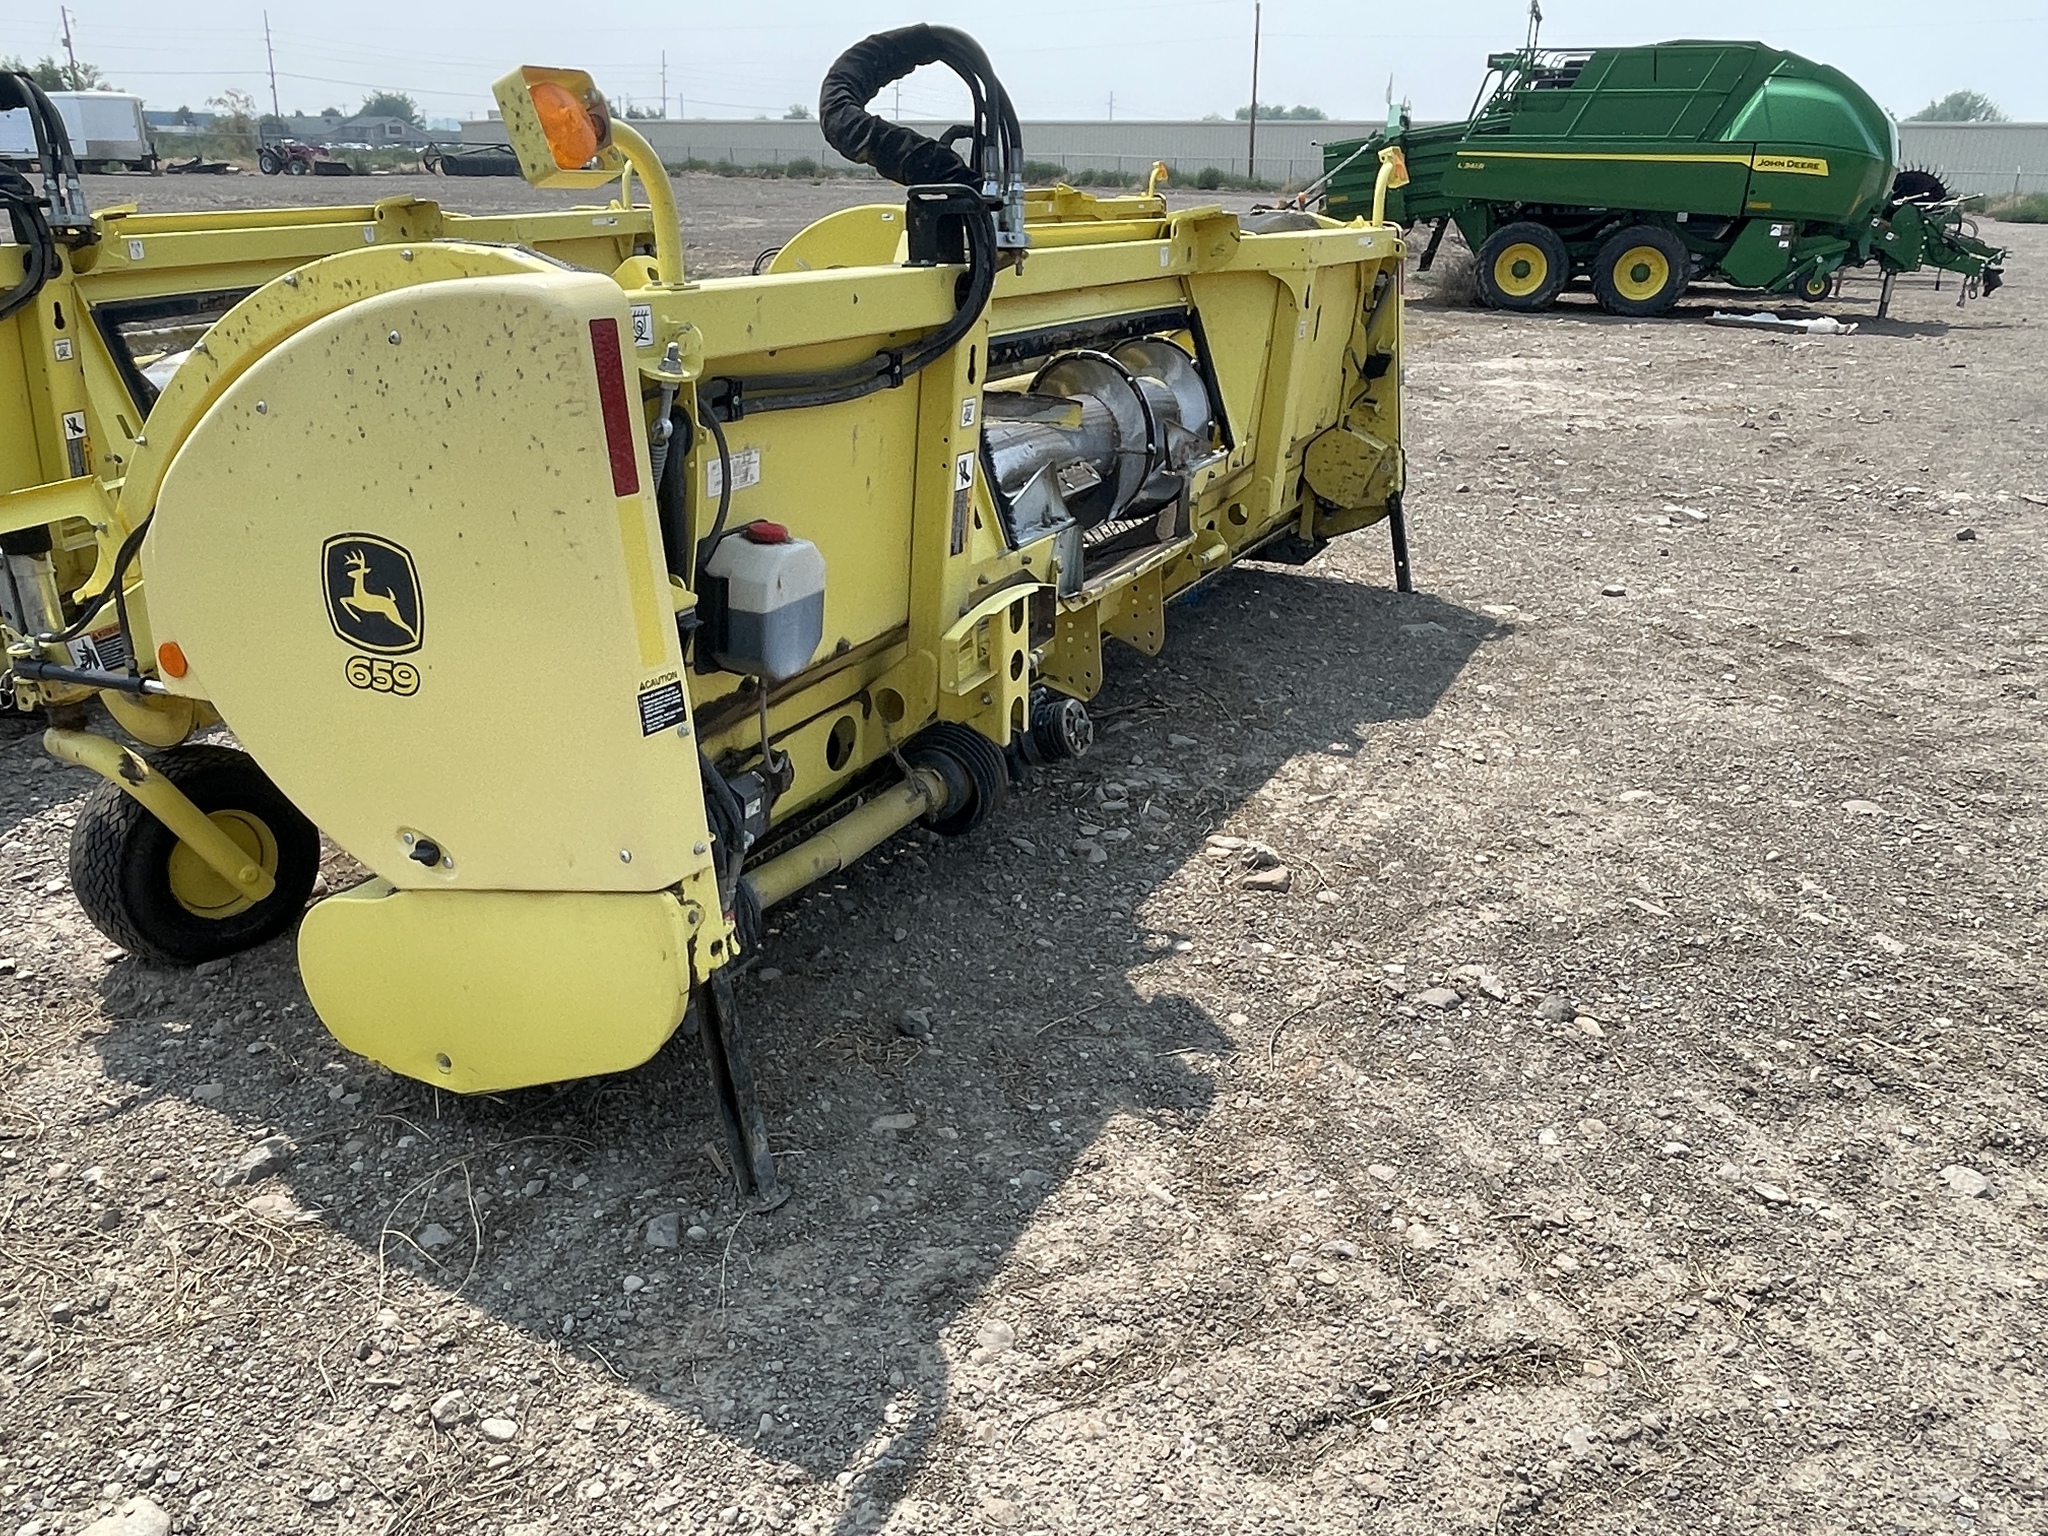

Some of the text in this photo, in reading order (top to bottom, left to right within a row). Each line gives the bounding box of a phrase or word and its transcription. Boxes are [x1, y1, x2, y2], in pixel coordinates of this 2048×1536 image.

[1758, 159, 1820, 170] JOHN DEERE
[345, 655, 421, 697] 659
[645, 671, 678, 689] CAUTION
